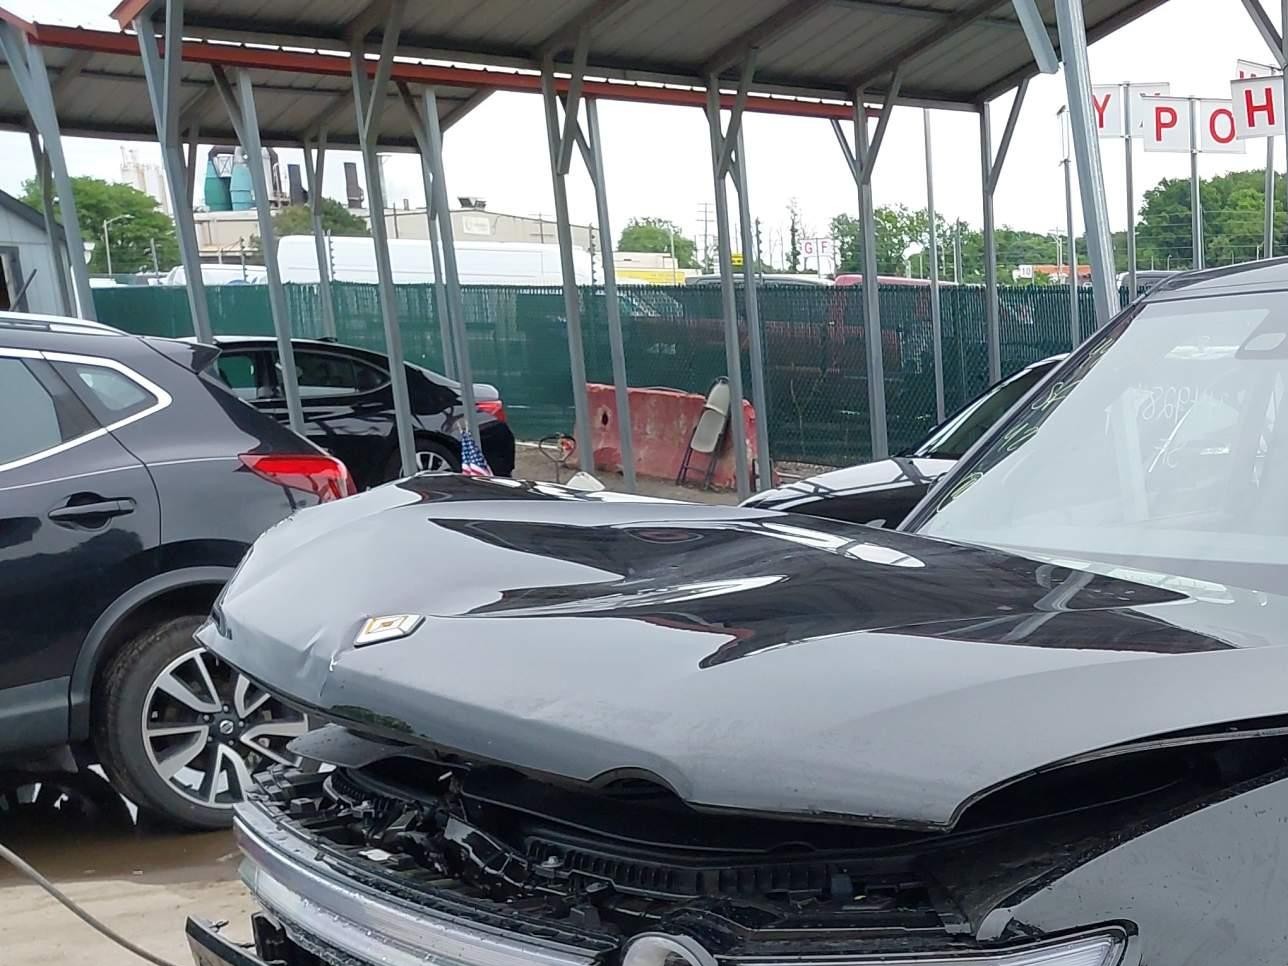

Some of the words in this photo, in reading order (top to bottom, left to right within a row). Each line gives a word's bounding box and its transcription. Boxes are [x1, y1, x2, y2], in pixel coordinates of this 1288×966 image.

[1091, 93, 1112, 129] Y
[1155, 106, 1178, 142] P
[1244, 87, 1275, 127] H
[1209, 108, 1236, 144] O
[821, 241, 828, 254] F
